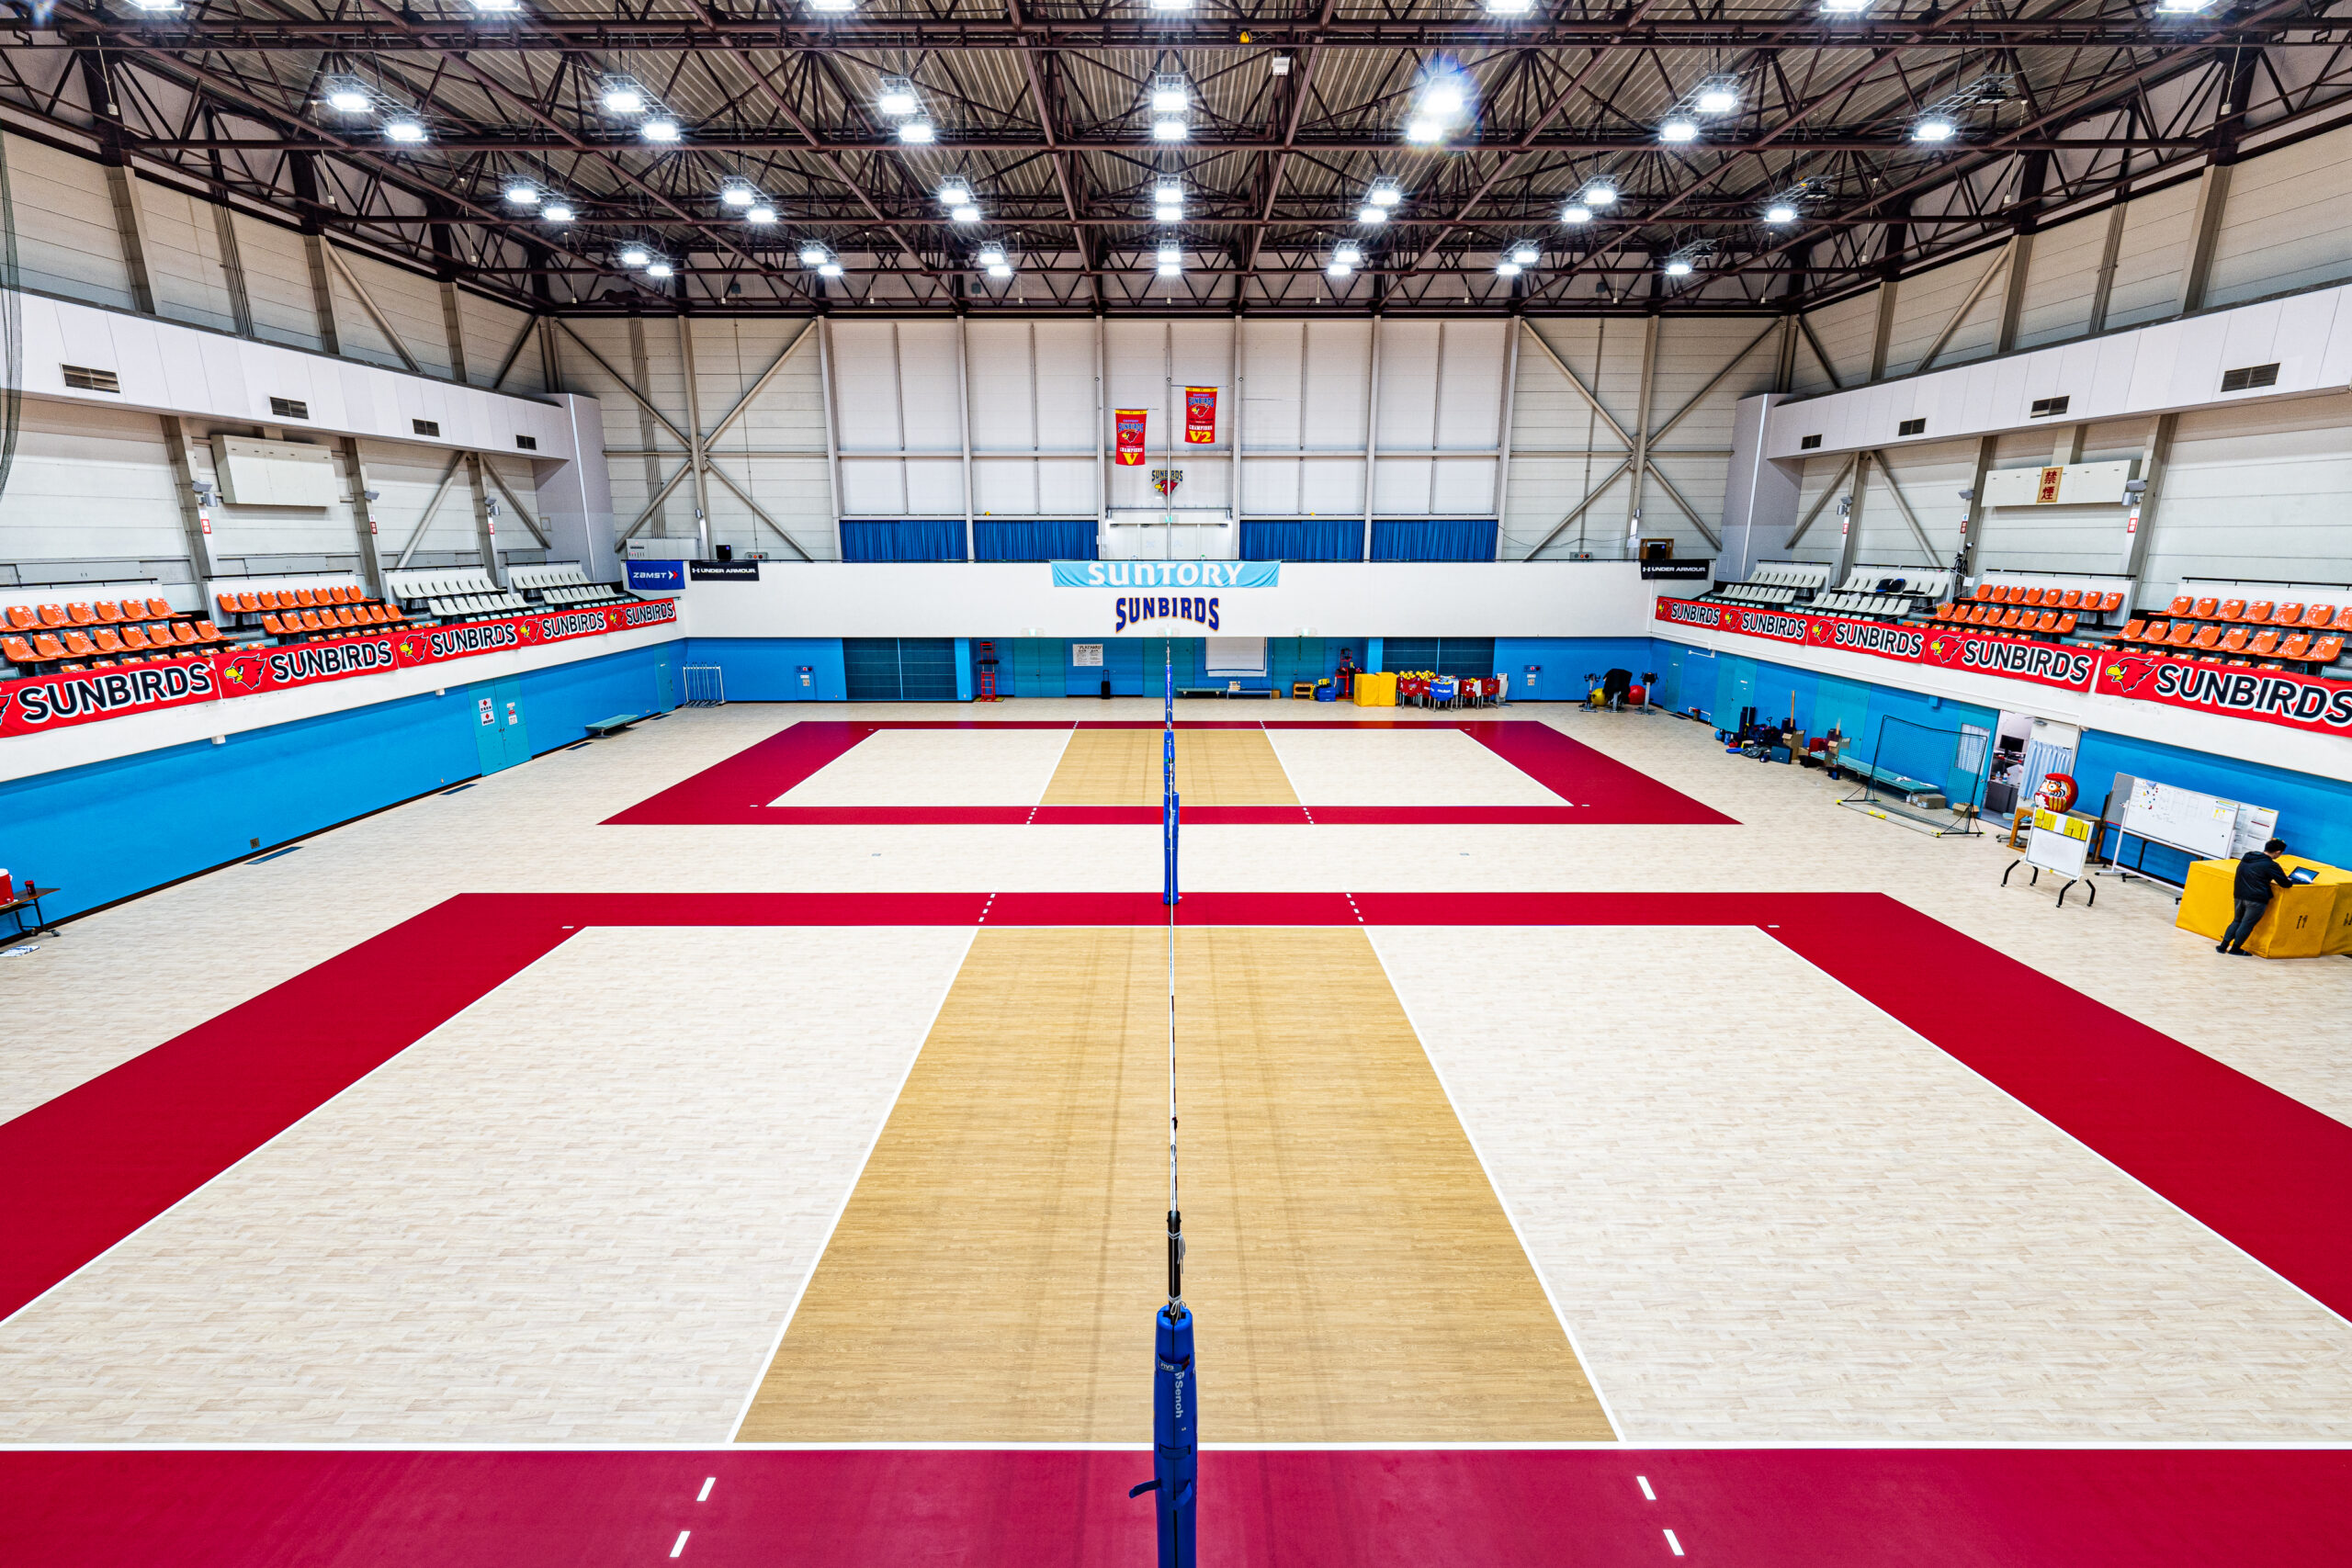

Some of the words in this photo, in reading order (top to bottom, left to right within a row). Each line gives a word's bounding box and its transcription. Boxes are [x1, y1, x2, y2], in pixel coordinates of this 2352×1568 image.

[1188, 397, 1215, 408] SUNBIRDS
[1118, 423, 1144, 433] SUNBIRDS
[1189, 431, 1211, 442] V2
[1124, 453, 1138, 465] V
[1151, 469, 1183, 482] SUNBRDS
[2041, 471, 2057, 500] 禁煙
[542, 612, 606, 639] SUNBIRDS
[626, 602, 675, 626] SUNBIRDS
[1115, 597, 1220, 634] SUNBIRDS
[1671, 602, 1721, 626] SUNBIRDS
[1741, 612, 1807, 640] SUNBIRDS
[431, 623, 517, 657] SUNBIRDS
[1835, 622, 1925, 658] SUNBIRDS
[270, 641, 393, 682] SUNBIRDS
[1962, 638, 2091, 683] SUNBIRDS
[18, 663, 213, 723] SUNBIRDS
[2154, 663, 2352, 728] SUNBIRDS
[1175, 1380, 1184, 1418] Senoh
